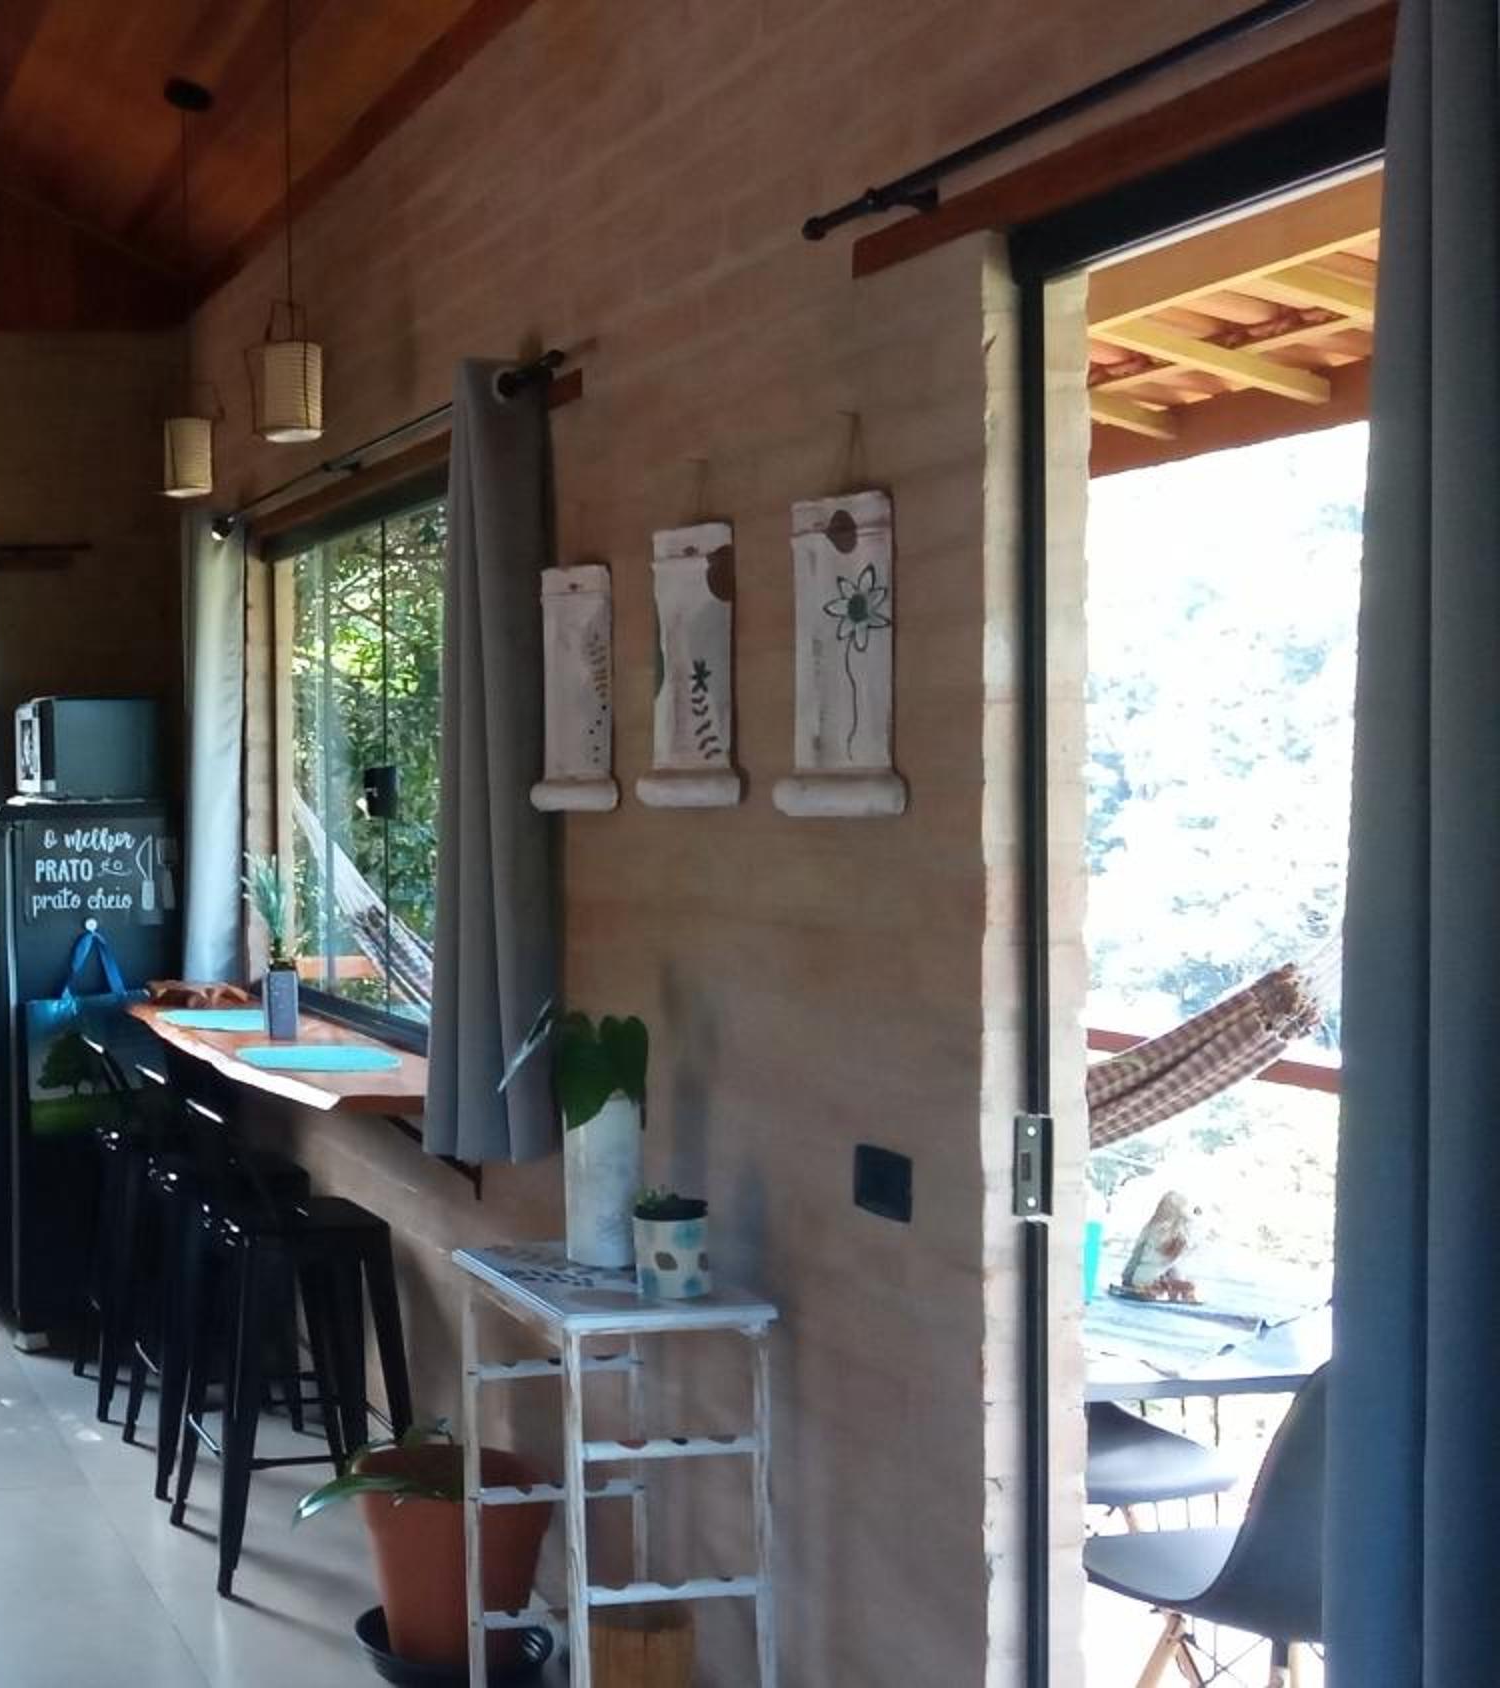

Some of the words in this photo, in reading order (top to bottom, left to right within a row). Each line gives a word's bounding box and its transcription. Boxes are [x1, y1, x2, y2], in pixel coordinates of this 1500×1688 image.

[63, 827, 136, 853] melhor
[35, 859, 93, 883] PRATO
[32, 887, 81, 918] prato
[86, 886, 133, 909] cheio
